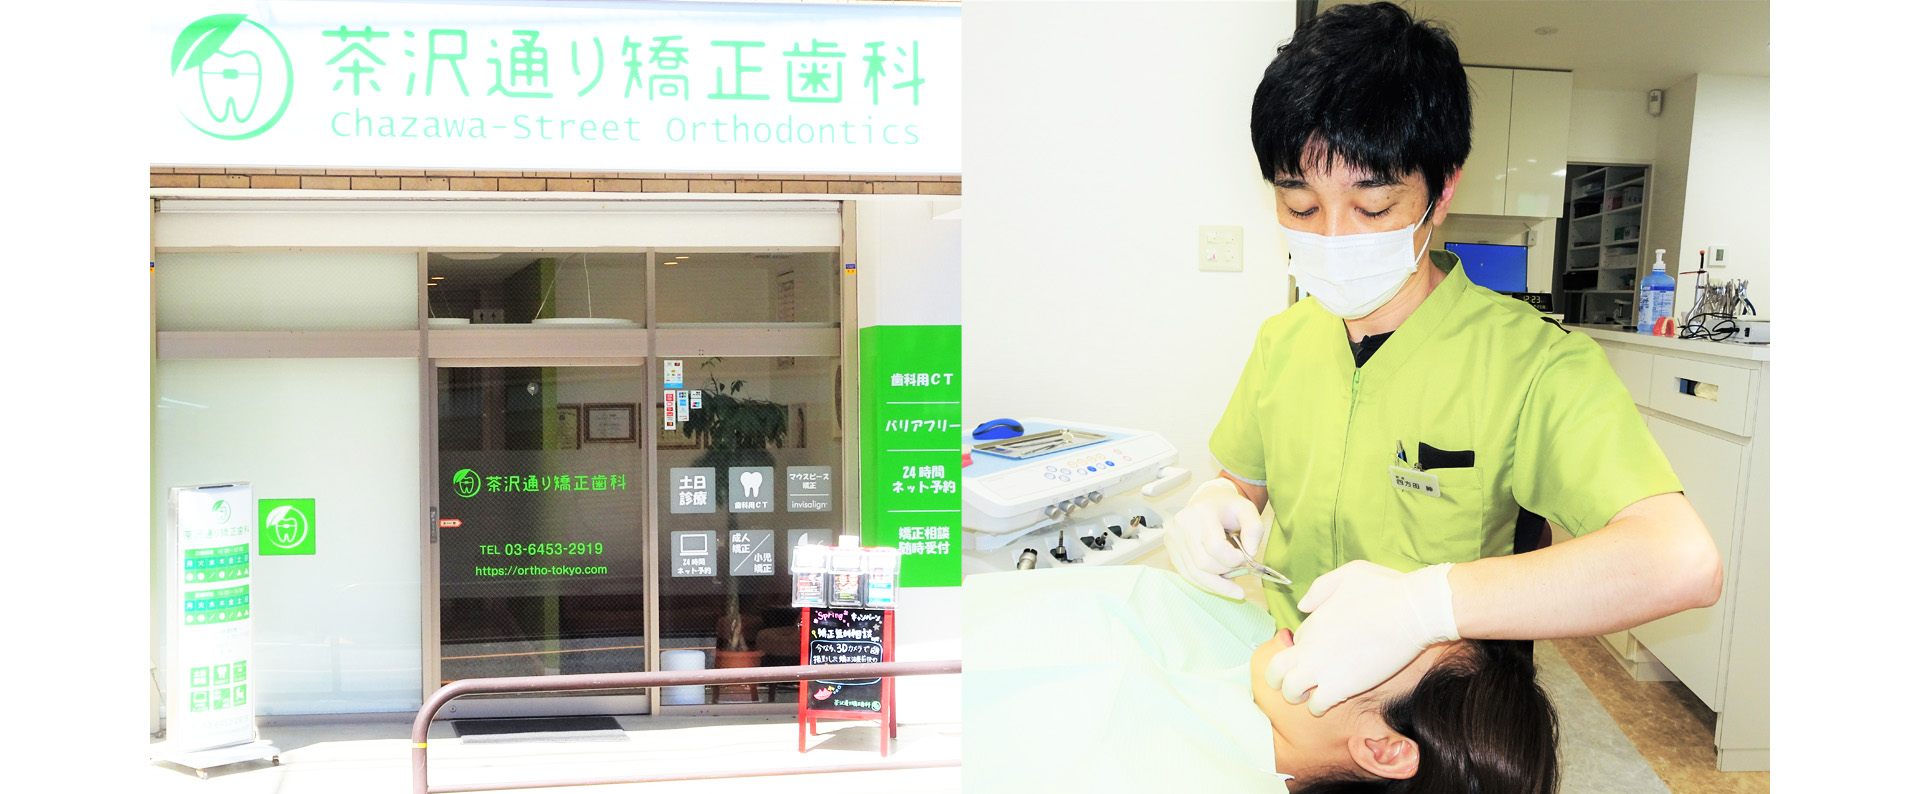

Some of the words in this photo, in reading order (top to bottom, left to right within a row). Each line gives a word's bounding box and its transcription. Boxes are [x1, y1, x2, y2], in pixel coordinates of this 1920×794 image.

[321, 24, 927, 107] 茶沢通り矯正歯科
[330, 109, 642, 143] Chazawa-Street
[665, 113, 920, 146] Orthodontics
[885, 419, 962, 432] バリアフリー
[486, 474, 627, 493] 茶沢通り矯正歯科
[678, 475, 707, 490] 土日
[789, 473, 830, 481] マウスピース
[802, 481, 817, 490] 矯正
[892, 480, 956, 494] ネット予約
[678, 491, 707, 506] 診療
[732, 533, 750, 543] 成人
[898, 526, 950, 540] 矯正相談
[479, 545, 501, 555] TEL
[504, 542, 603, 556] 03-6453-2919
[732, 544, 750, 554] 矯正
[898, 541, 951, 556] 随時受付
[753, 552, 772, 563] 小児
[475, 565, 608, 577] https://ortho-tokyo.com
[677, 567, 712, 575] ネット予約
[753, 564, 773, 574] 矯正
